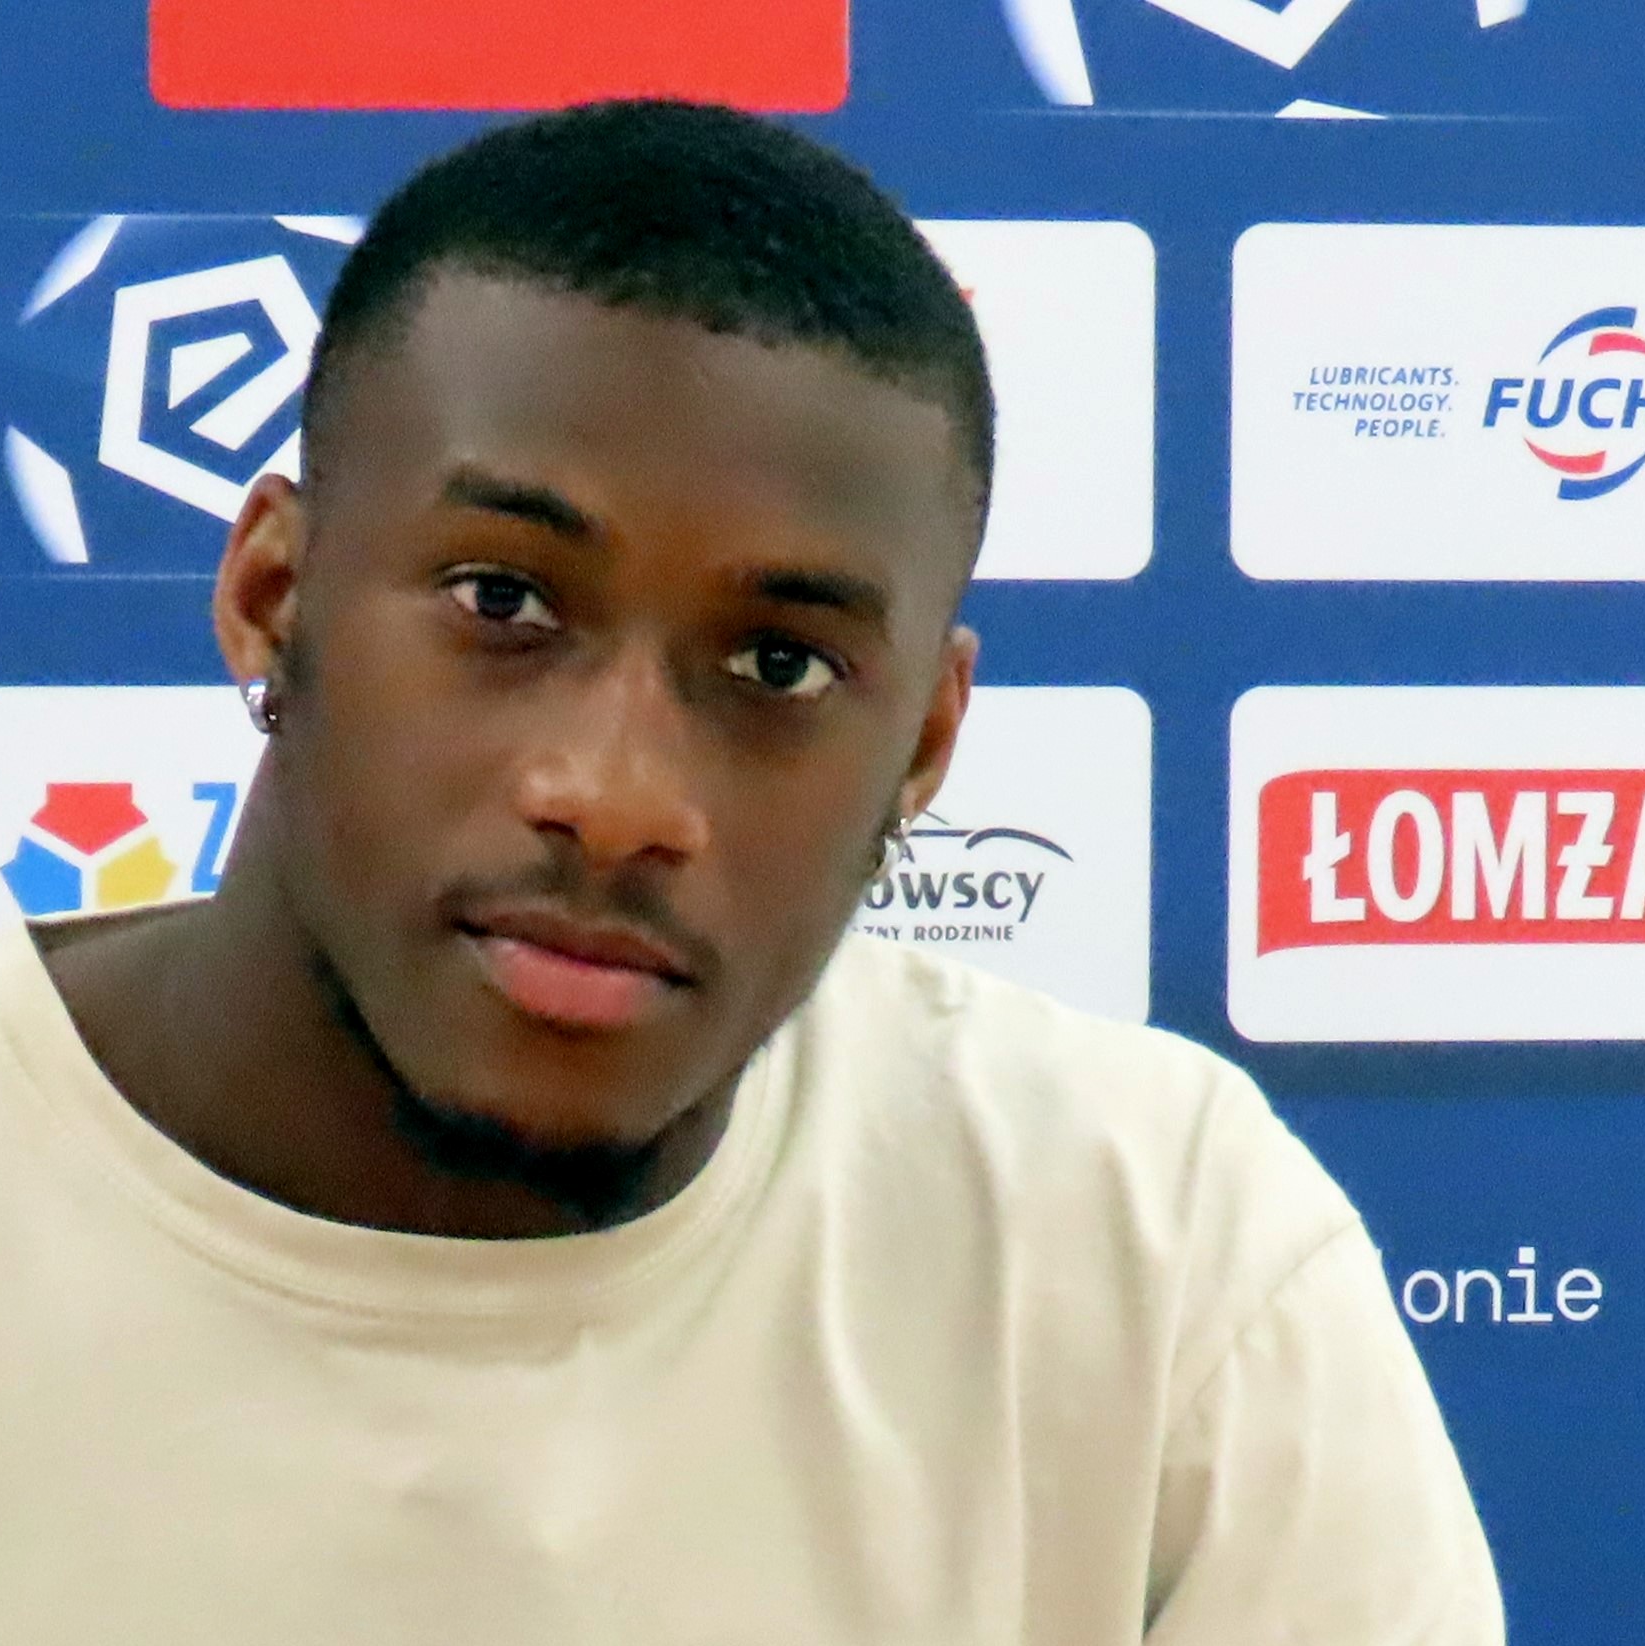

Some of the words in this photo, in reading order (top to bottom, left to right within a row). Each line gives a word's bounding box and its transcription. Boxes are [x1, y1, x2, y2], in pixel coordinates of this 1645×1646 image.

[1309, 366, 1459, 386] LUBRICANTS.
[1292, 392, 1453, 413] TECHNOLOGY.
[1354, 418, 1446, 438] PEOPLE.
[913, 925, 1015, 942] RODZINIE
[1402, 1246, 1604, 1324] onie
